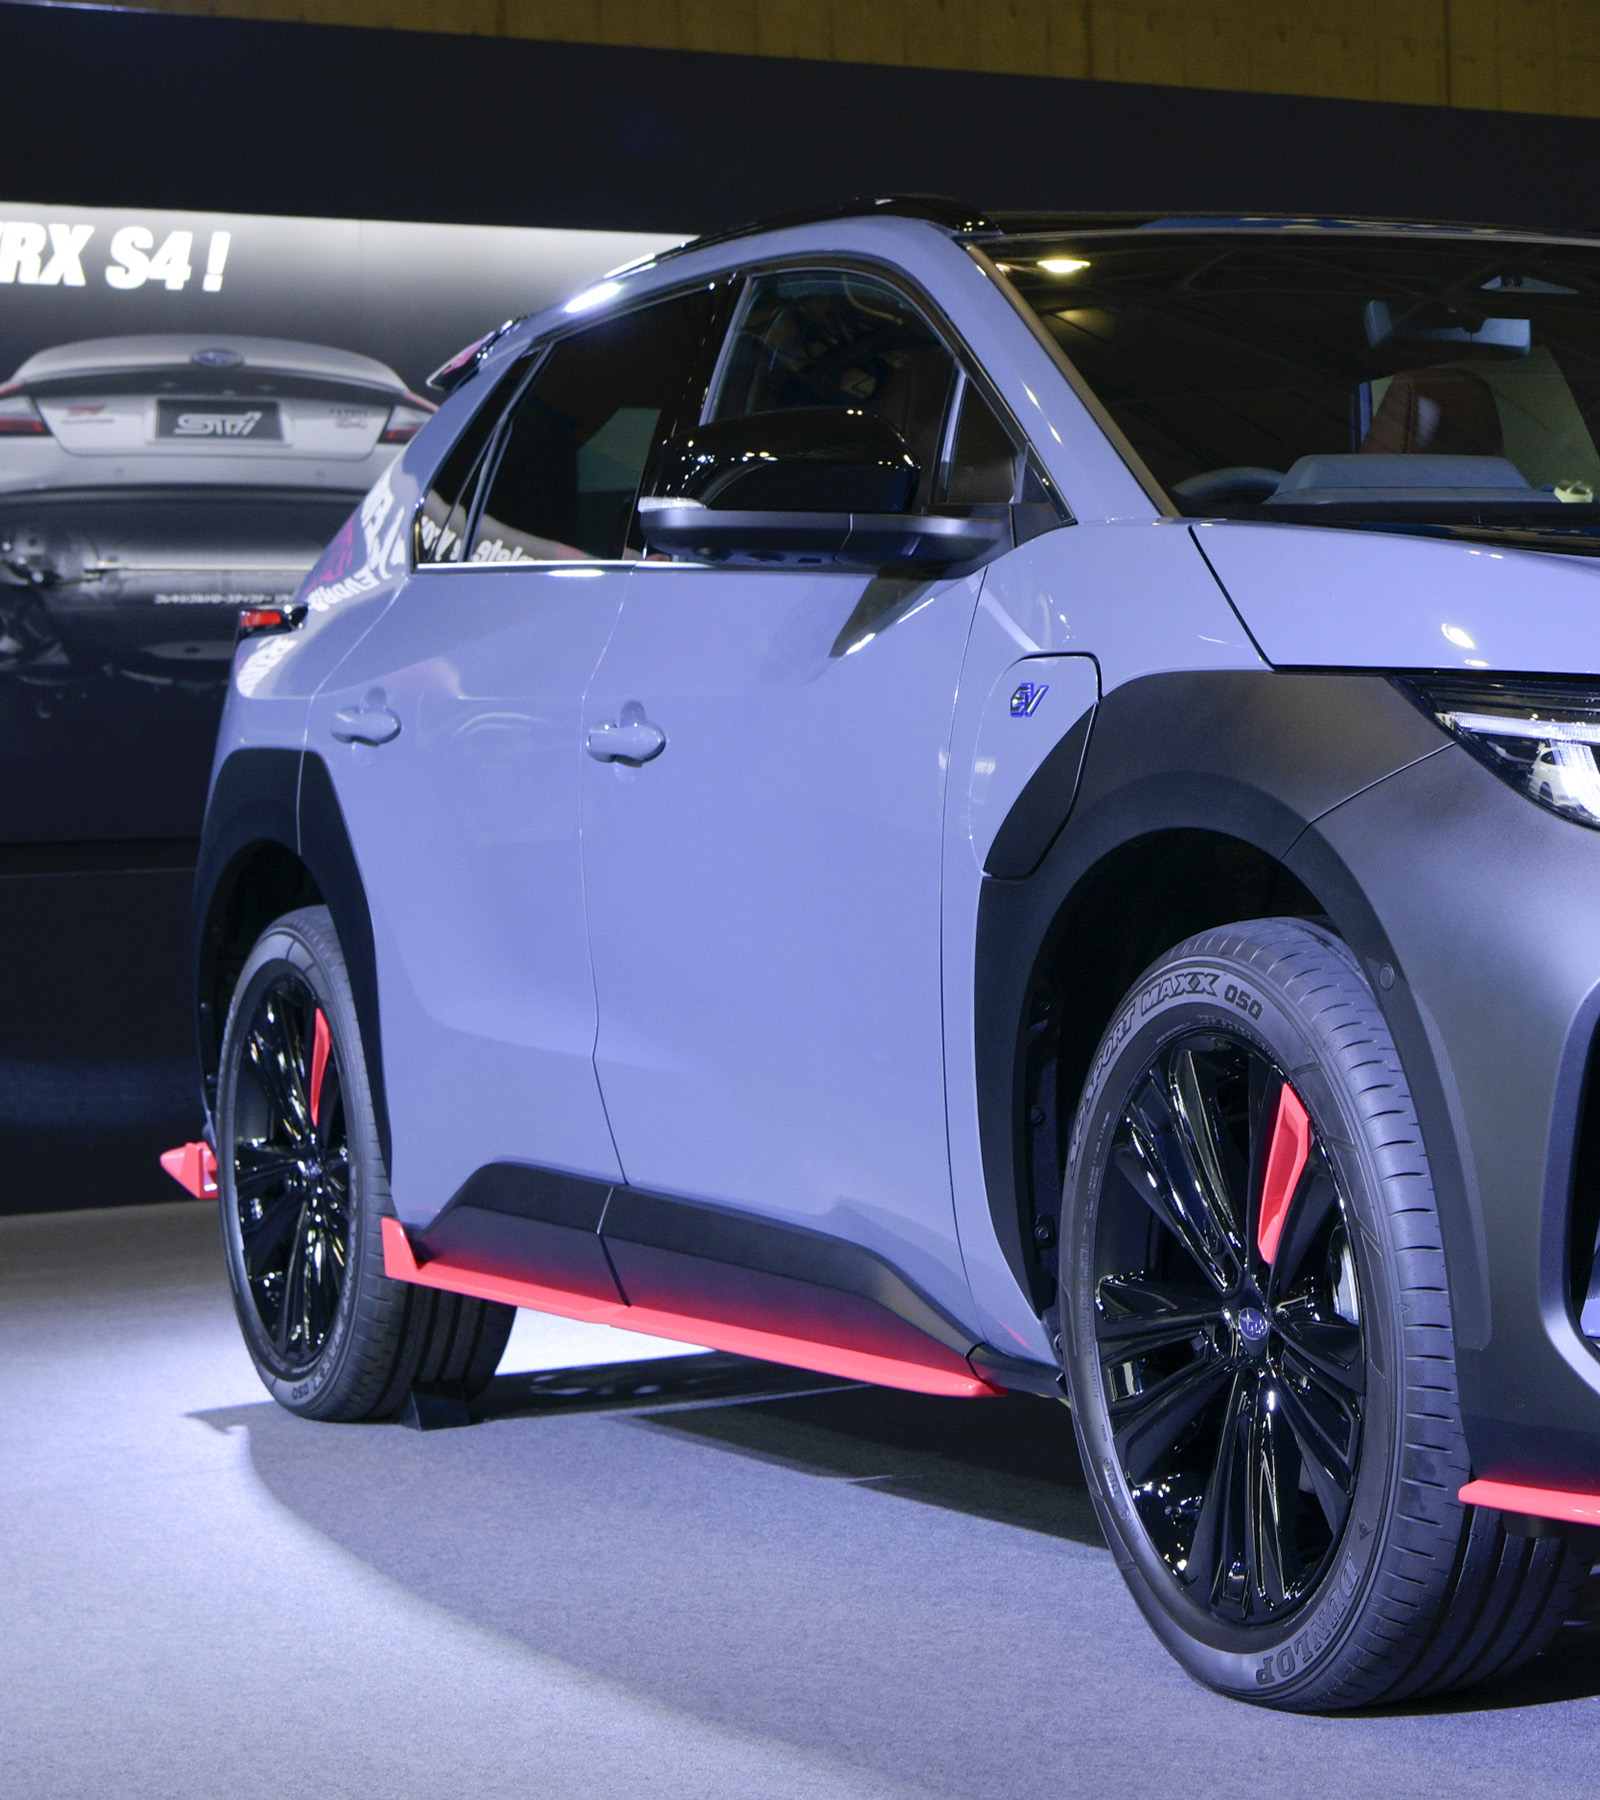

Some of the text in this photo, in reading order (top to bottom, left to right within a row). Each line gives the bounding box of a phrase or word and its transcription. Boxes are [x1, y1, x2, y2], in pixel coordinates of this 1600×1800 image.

[0, 221, 95, 286] RX
[1010, 682, 1049, 718] EV
[1085, 1004, 1136, 1114] SPORT
[1141, 972, 1220, 1017] MAXX
[1224, 984, 1264, 1020] 050
[1256, 1552, 1360, 1686] DUNLOP
